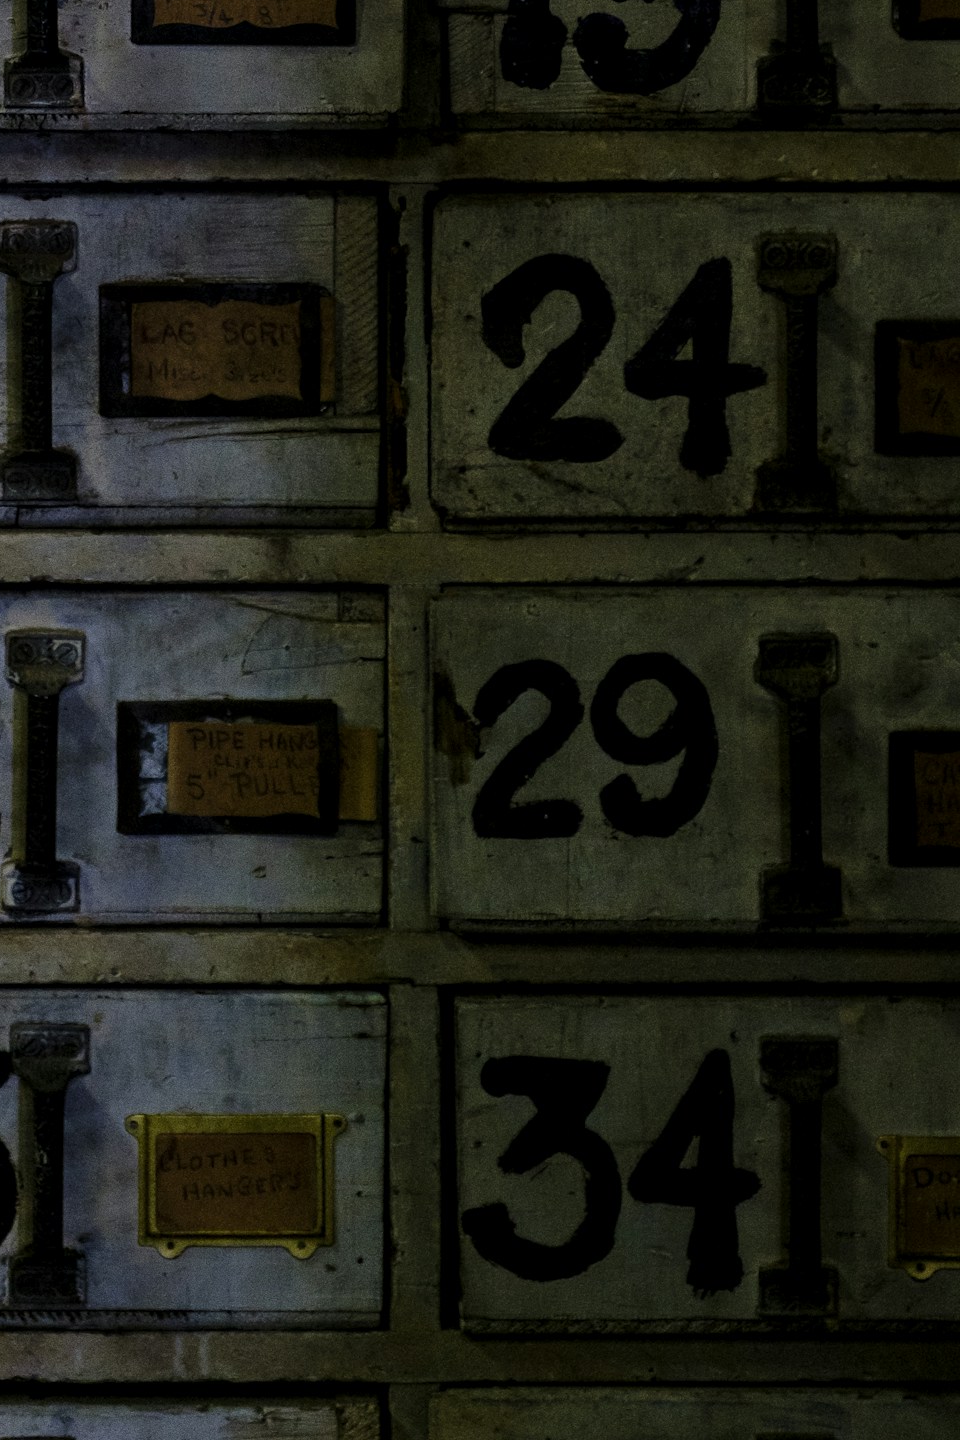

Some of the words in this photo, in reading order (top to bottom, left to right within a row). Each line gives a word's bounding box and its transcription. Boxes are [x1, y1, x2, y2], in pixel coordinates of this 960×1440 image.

[140, 320, 196, 345] LAG
[480, 253, 768, 475] 24
[186, 728, 244, 752] PIPE
[472, 652, 720, 838] 29
[461, 1048, 761, 1297] 34
